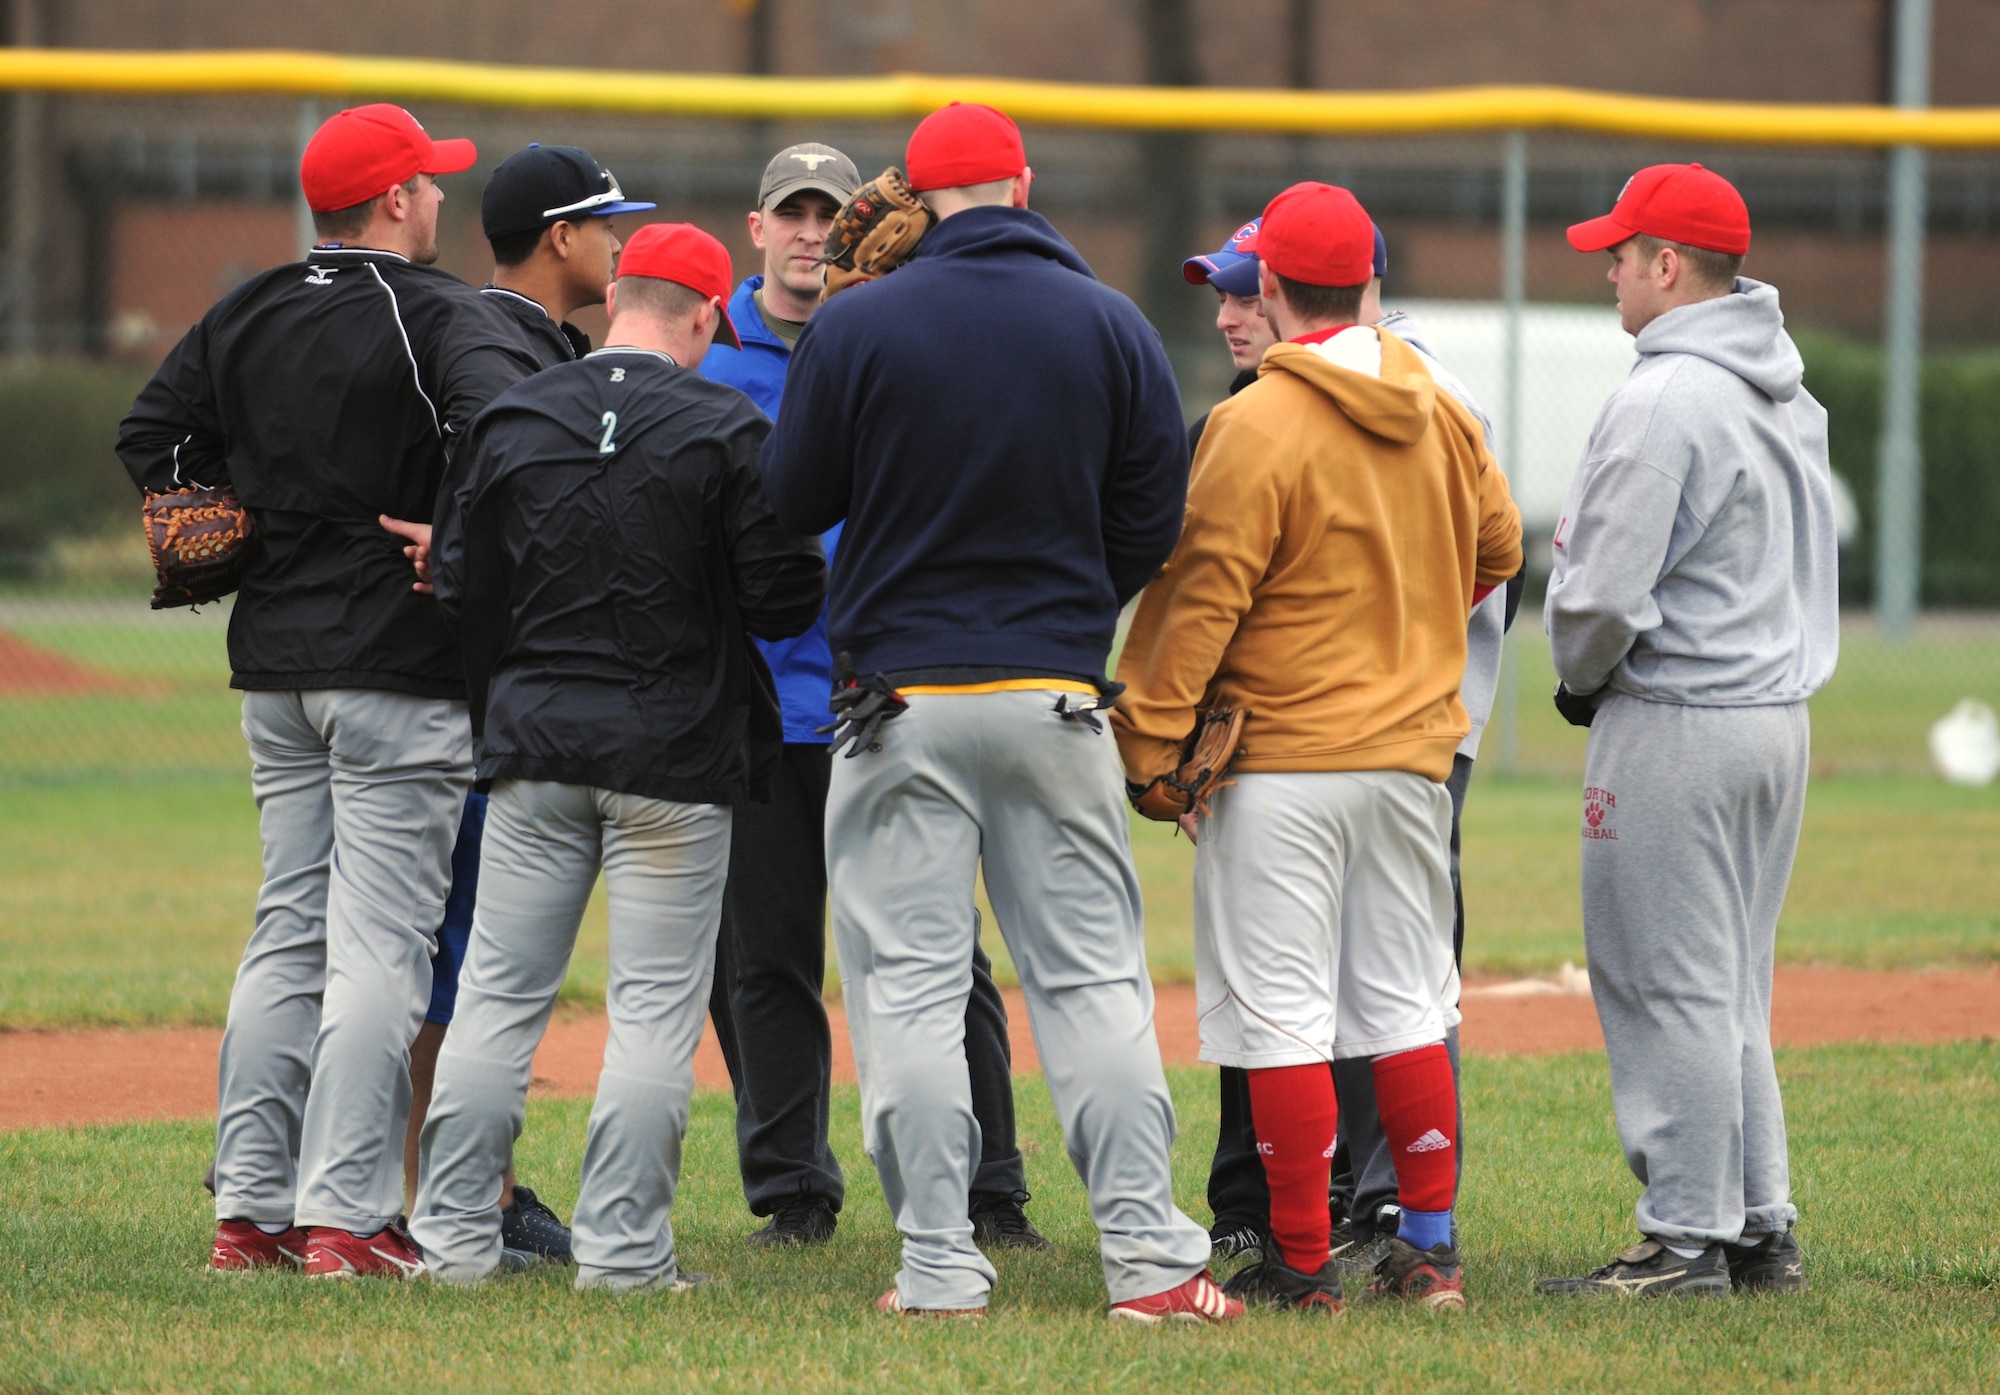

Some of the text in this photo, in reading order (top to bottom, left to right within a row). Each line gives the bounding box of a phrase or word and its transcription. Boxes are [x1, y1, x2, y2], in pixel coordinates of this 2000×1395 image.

[1233, 222, 1258, 243] C
[609, 367, 626, 382] B
[599, 410, 618, 454] 2
[1583, 787, 1617, 808] ORTH
[1406, 1139, 1452, 1153] adidas
